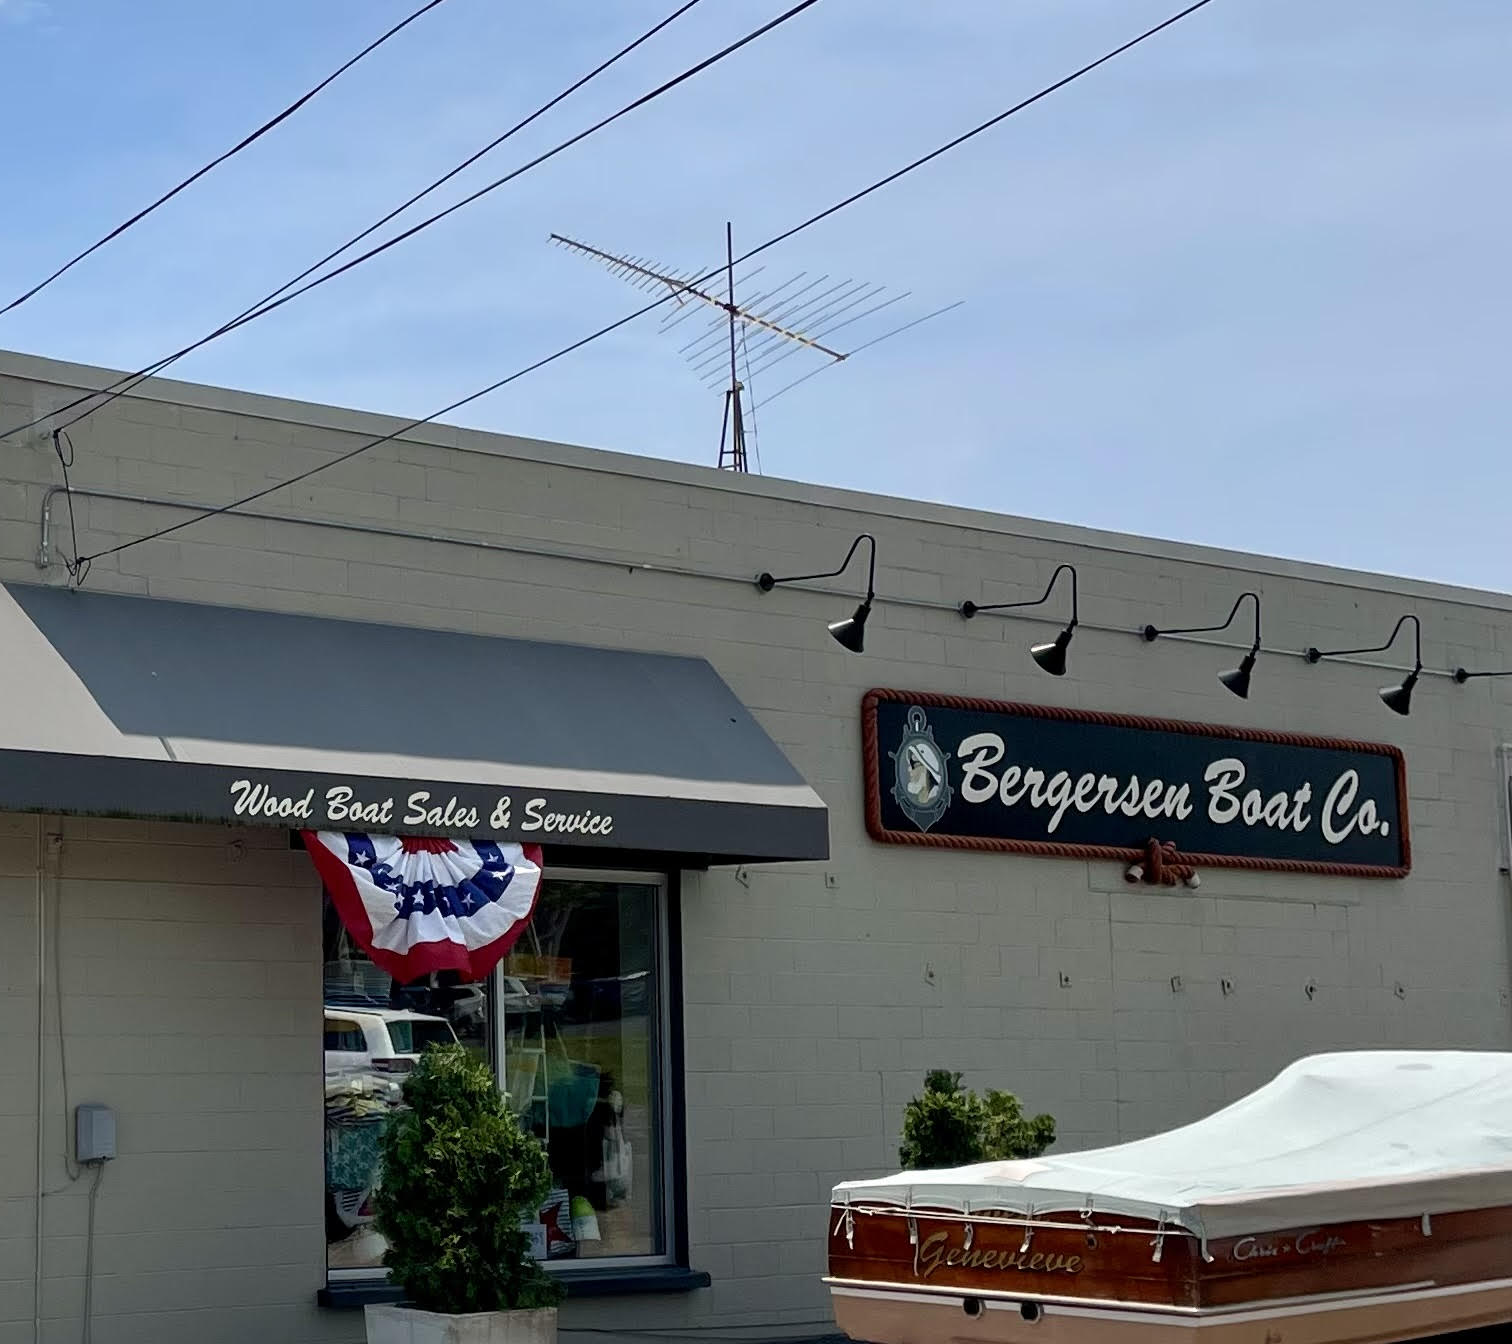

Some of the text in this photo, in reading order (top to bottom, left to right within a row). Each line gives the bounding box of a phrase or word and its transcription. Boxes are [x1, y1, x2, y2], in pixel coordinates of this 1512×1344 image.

[230, 779, 614, 835] Wood Boat Sales & Service
[957, 732, 1390, 845] Bergersen Boat Co.
[919, 1231, 1087, 1279] Genevieve
